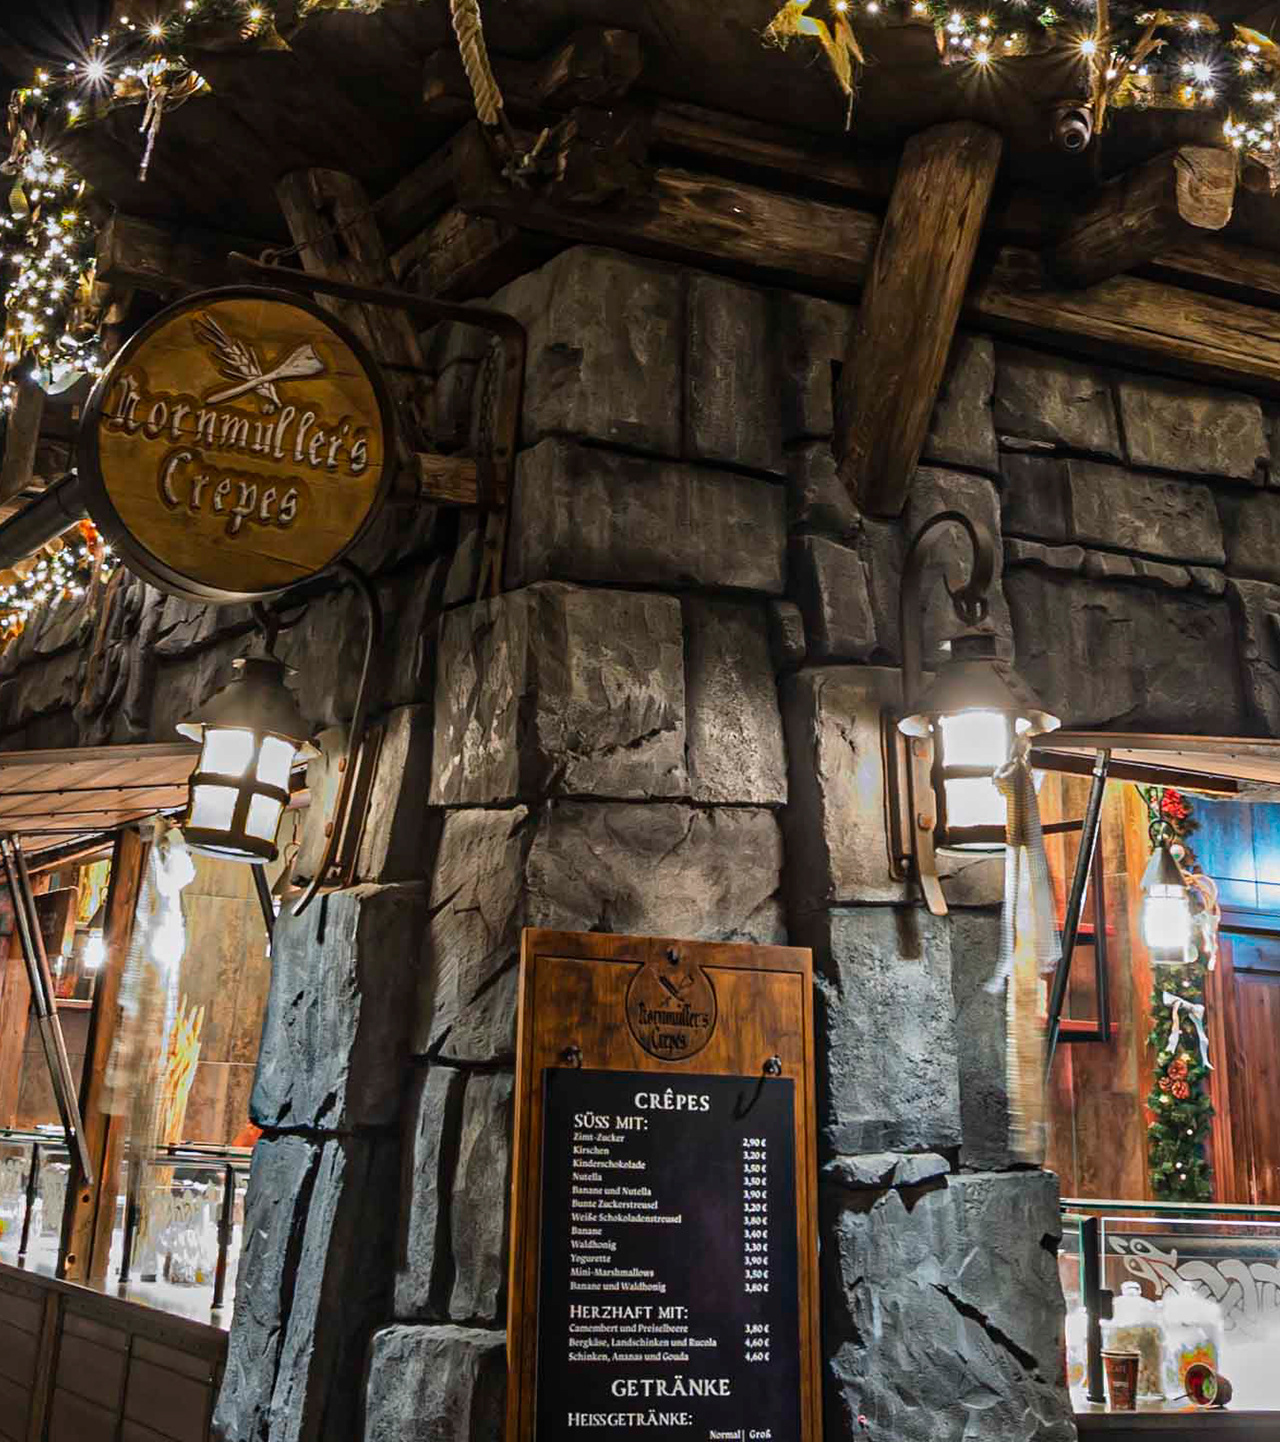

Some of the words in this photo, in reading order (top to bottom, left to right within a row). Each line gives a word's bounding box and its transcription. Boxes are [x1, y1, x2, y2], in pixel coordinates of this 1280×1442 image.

[635, 1088, 710, 1111] CRÊPES
[575, 1112, 609, 1129] SÜSS
[616, 1117, 648, 1130] MIT:
[573, 1133, 624, 1143] Zimt-Zucker
[743, 1139, 759, 1148] 2,90
[573, 1146, 609, 1155] Kirschen
[573, 1160, 646, 1169] Kinderschokolade
[573, 1173, 602, 1181] Nutella
[572, 1187, 603, 1195] Banane
[605, 1187, 620, 1195] und
[622, 1187, 651, 1196] Nutella
[572, 1199, 596, 1208] Bunte
[598, 1200, 658, 1209] Zuckerstreusel
[599, 1214, 681, 1223] Schokoladenstreusel
[571, 1227, 602, 1235] Banane
[571, 1240, 616, 1251] Waldhonig
[570, 1254, 611, 1264] Yogurette
[570, 1268, 654, 1278] Mini-Marshmallows
[570, 1282, 601, 1290] Banane
[603, 1282, 619, 1290] und
[621, 1282, 666, 1293] Waldhonig
[570, 1305, 652, 1318] HERZHAFT
[659, 1307, 688, 1319] MIT:
[569, 1324, 618, 1333] Camembert
[620, 1324, 636, 1333] und
[638, 1324, 688, 1333] Preiselbeere
[569, 1338, 609, 1348] Bergkäse,
[611, 1338, 669, 1347] Landschinken
[689, 1339, 717, 1347] Rucola
[569, 1352, 610, 1362] Schinken,
[612, 1352, 642, 1361] Ananas
[644, 1353, 661, 1361] und
[663, 1352, 689, 1361] Gouda
[612, 1376, 731, 1397] GETRÄNKE
[568, 1410, 692, 1426] HEISSGETRÄNKE:
[710, 1431, 741, 1439] Normal
[749, 1429, 771, 1439] Groß
